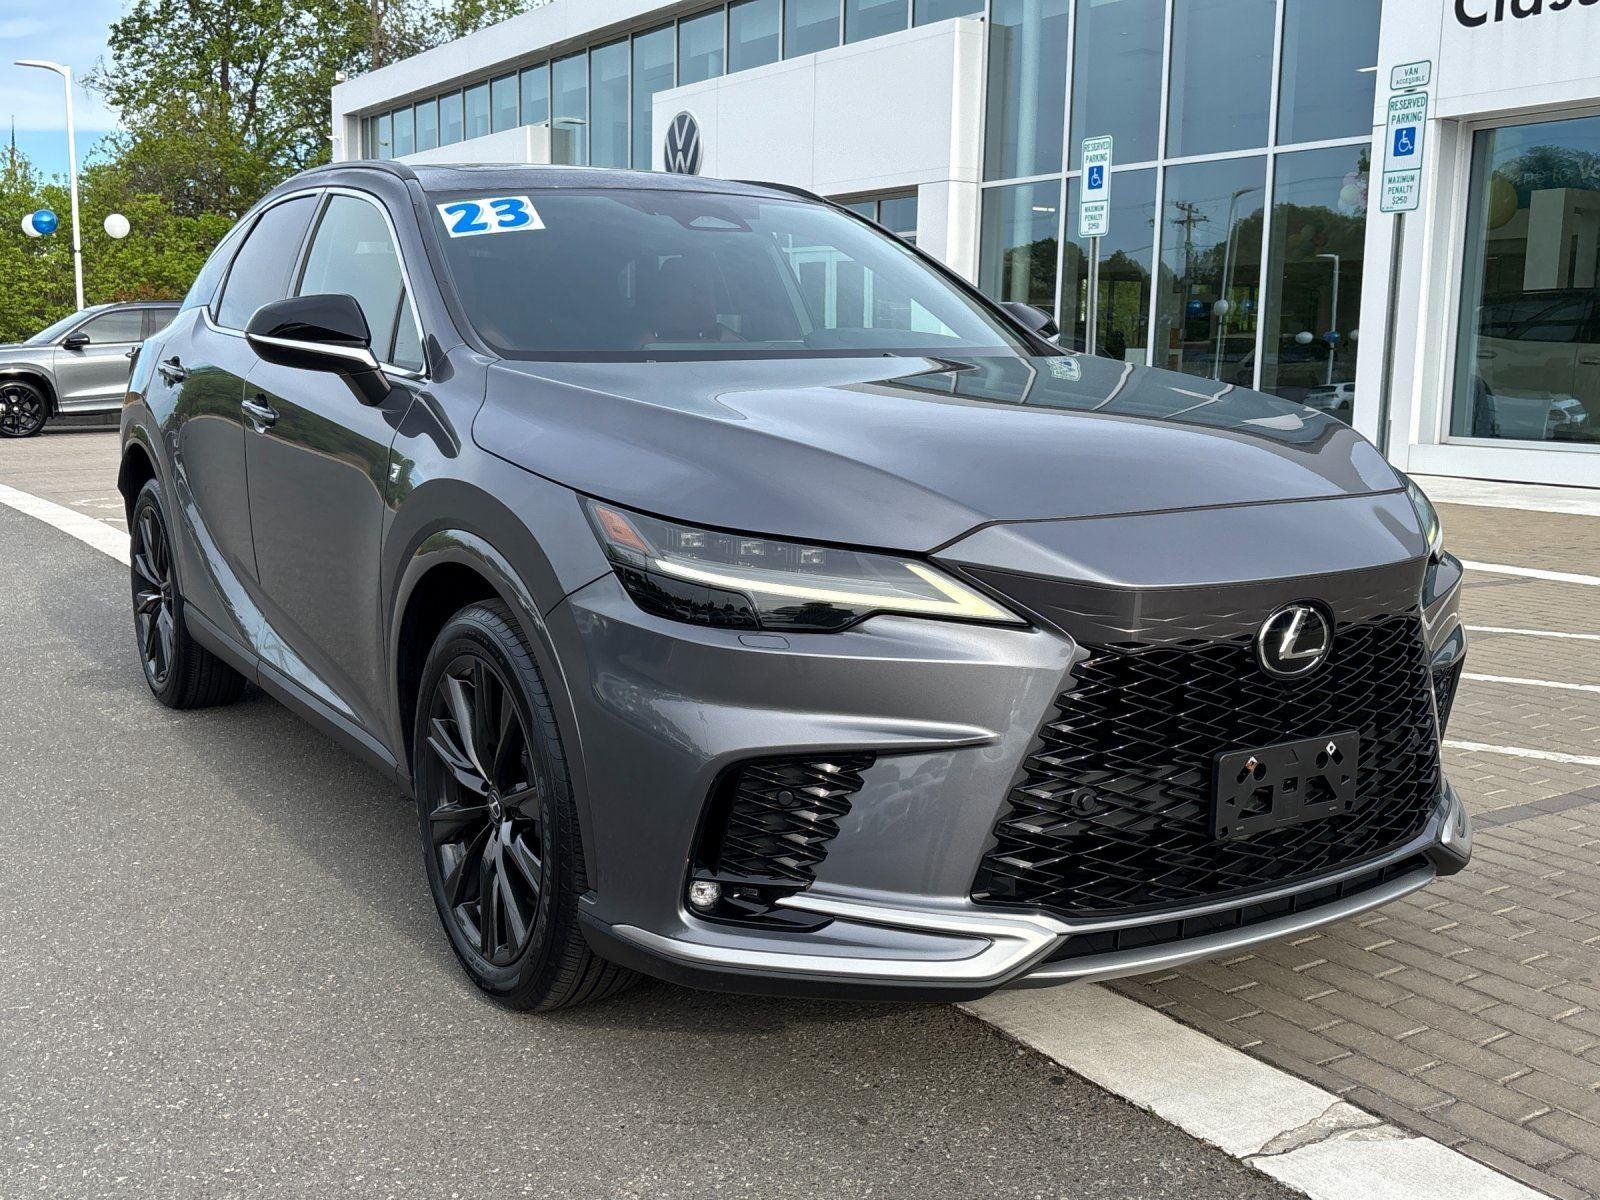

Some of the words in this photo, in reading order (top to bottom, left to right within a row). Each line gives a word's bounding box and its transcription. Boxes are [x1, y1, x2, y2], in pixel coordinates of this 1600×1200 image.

[1404, 67, 1419, 76] VAN
[1396, 75, 1425, 85] ACCESSIBLE
[1390, 96, 1425, 112] RESERVED
[1391, 111, 1422, 125] PARKING
[1084, 141, 1110, 152] RESERVED
[1085, 153, 1108, 164] PARKING
[1387, 174, 1415, 184] MAXIMUM
[1388, 185, 1413, 195] PENALTY
[1392, 196, 1408, 205] $250
[444, 199, 530, 233] 23
